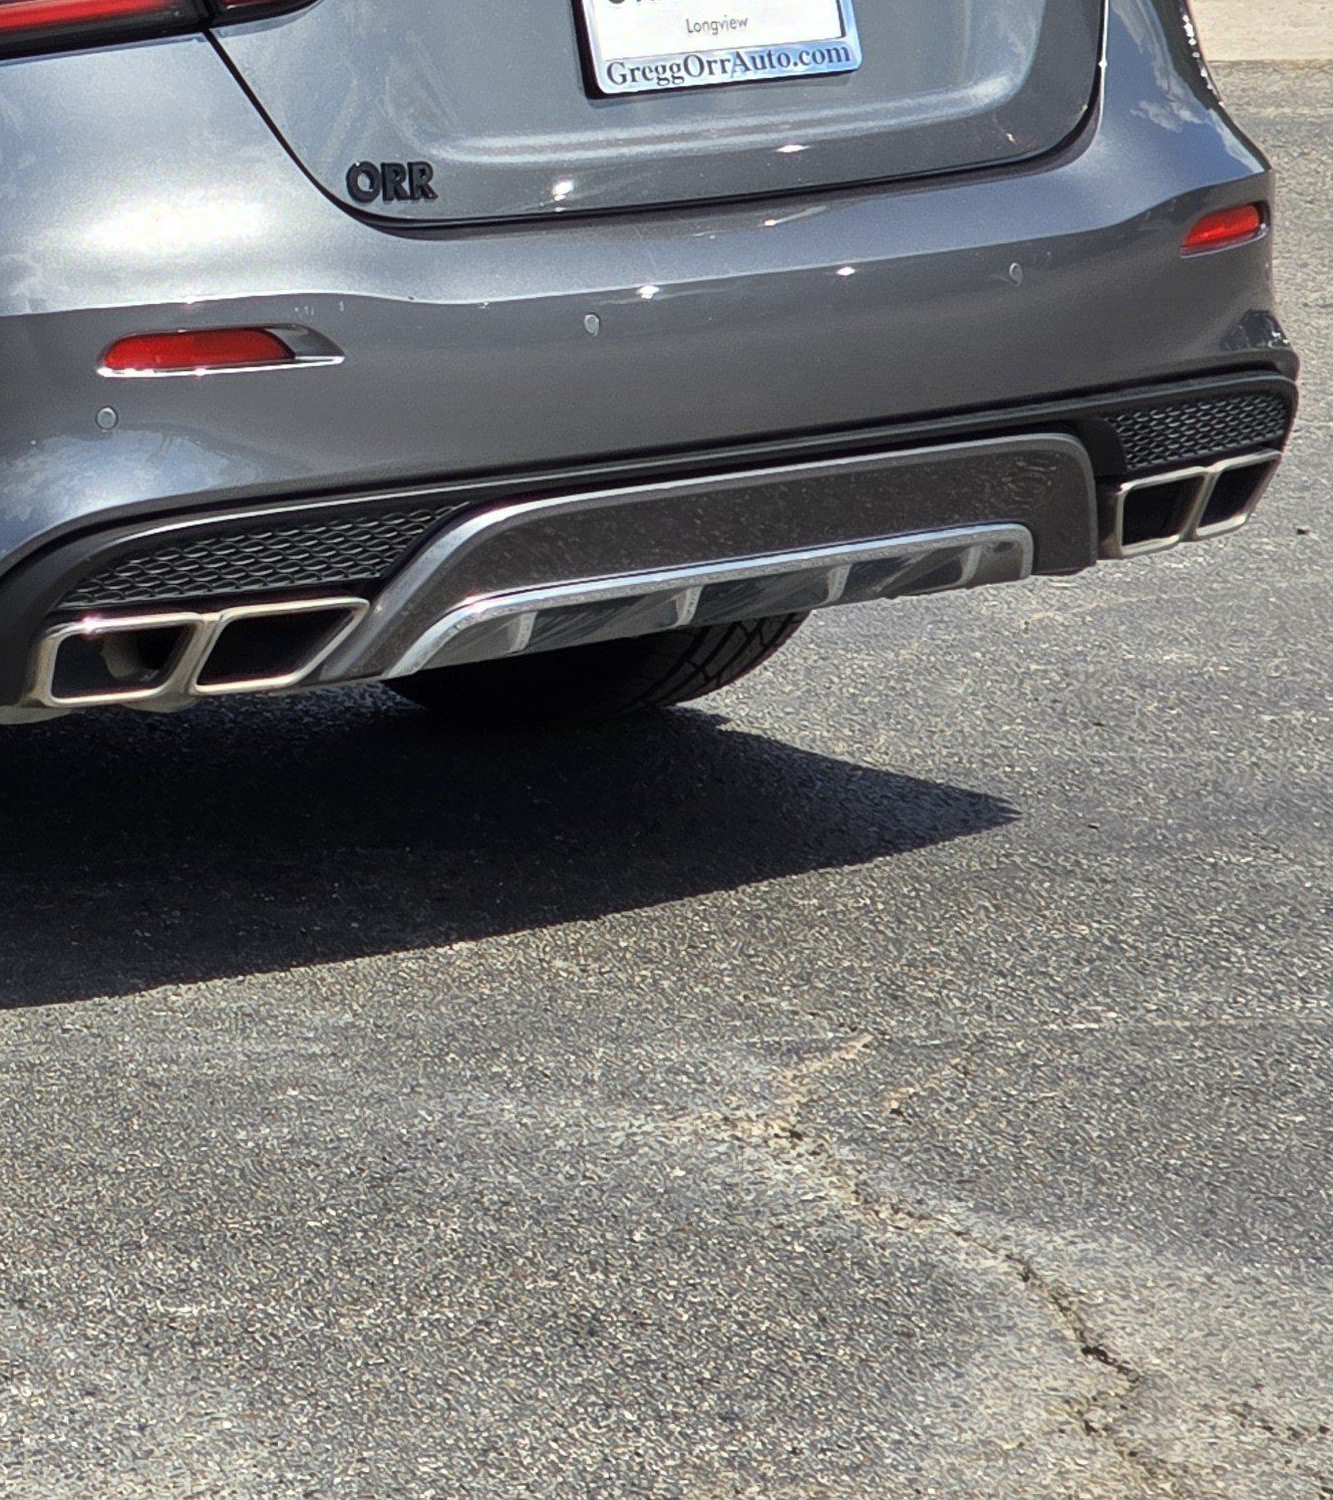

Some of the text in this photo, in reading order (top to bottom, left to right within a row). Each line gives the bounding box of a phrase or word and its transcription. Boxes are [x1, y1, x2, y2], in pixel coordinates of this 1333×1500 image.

[685, 14, 749, 36] Longview
[606, 45, 852, 86] GreggOrrAuto.com
[346, 161, 438, 204] ORR
